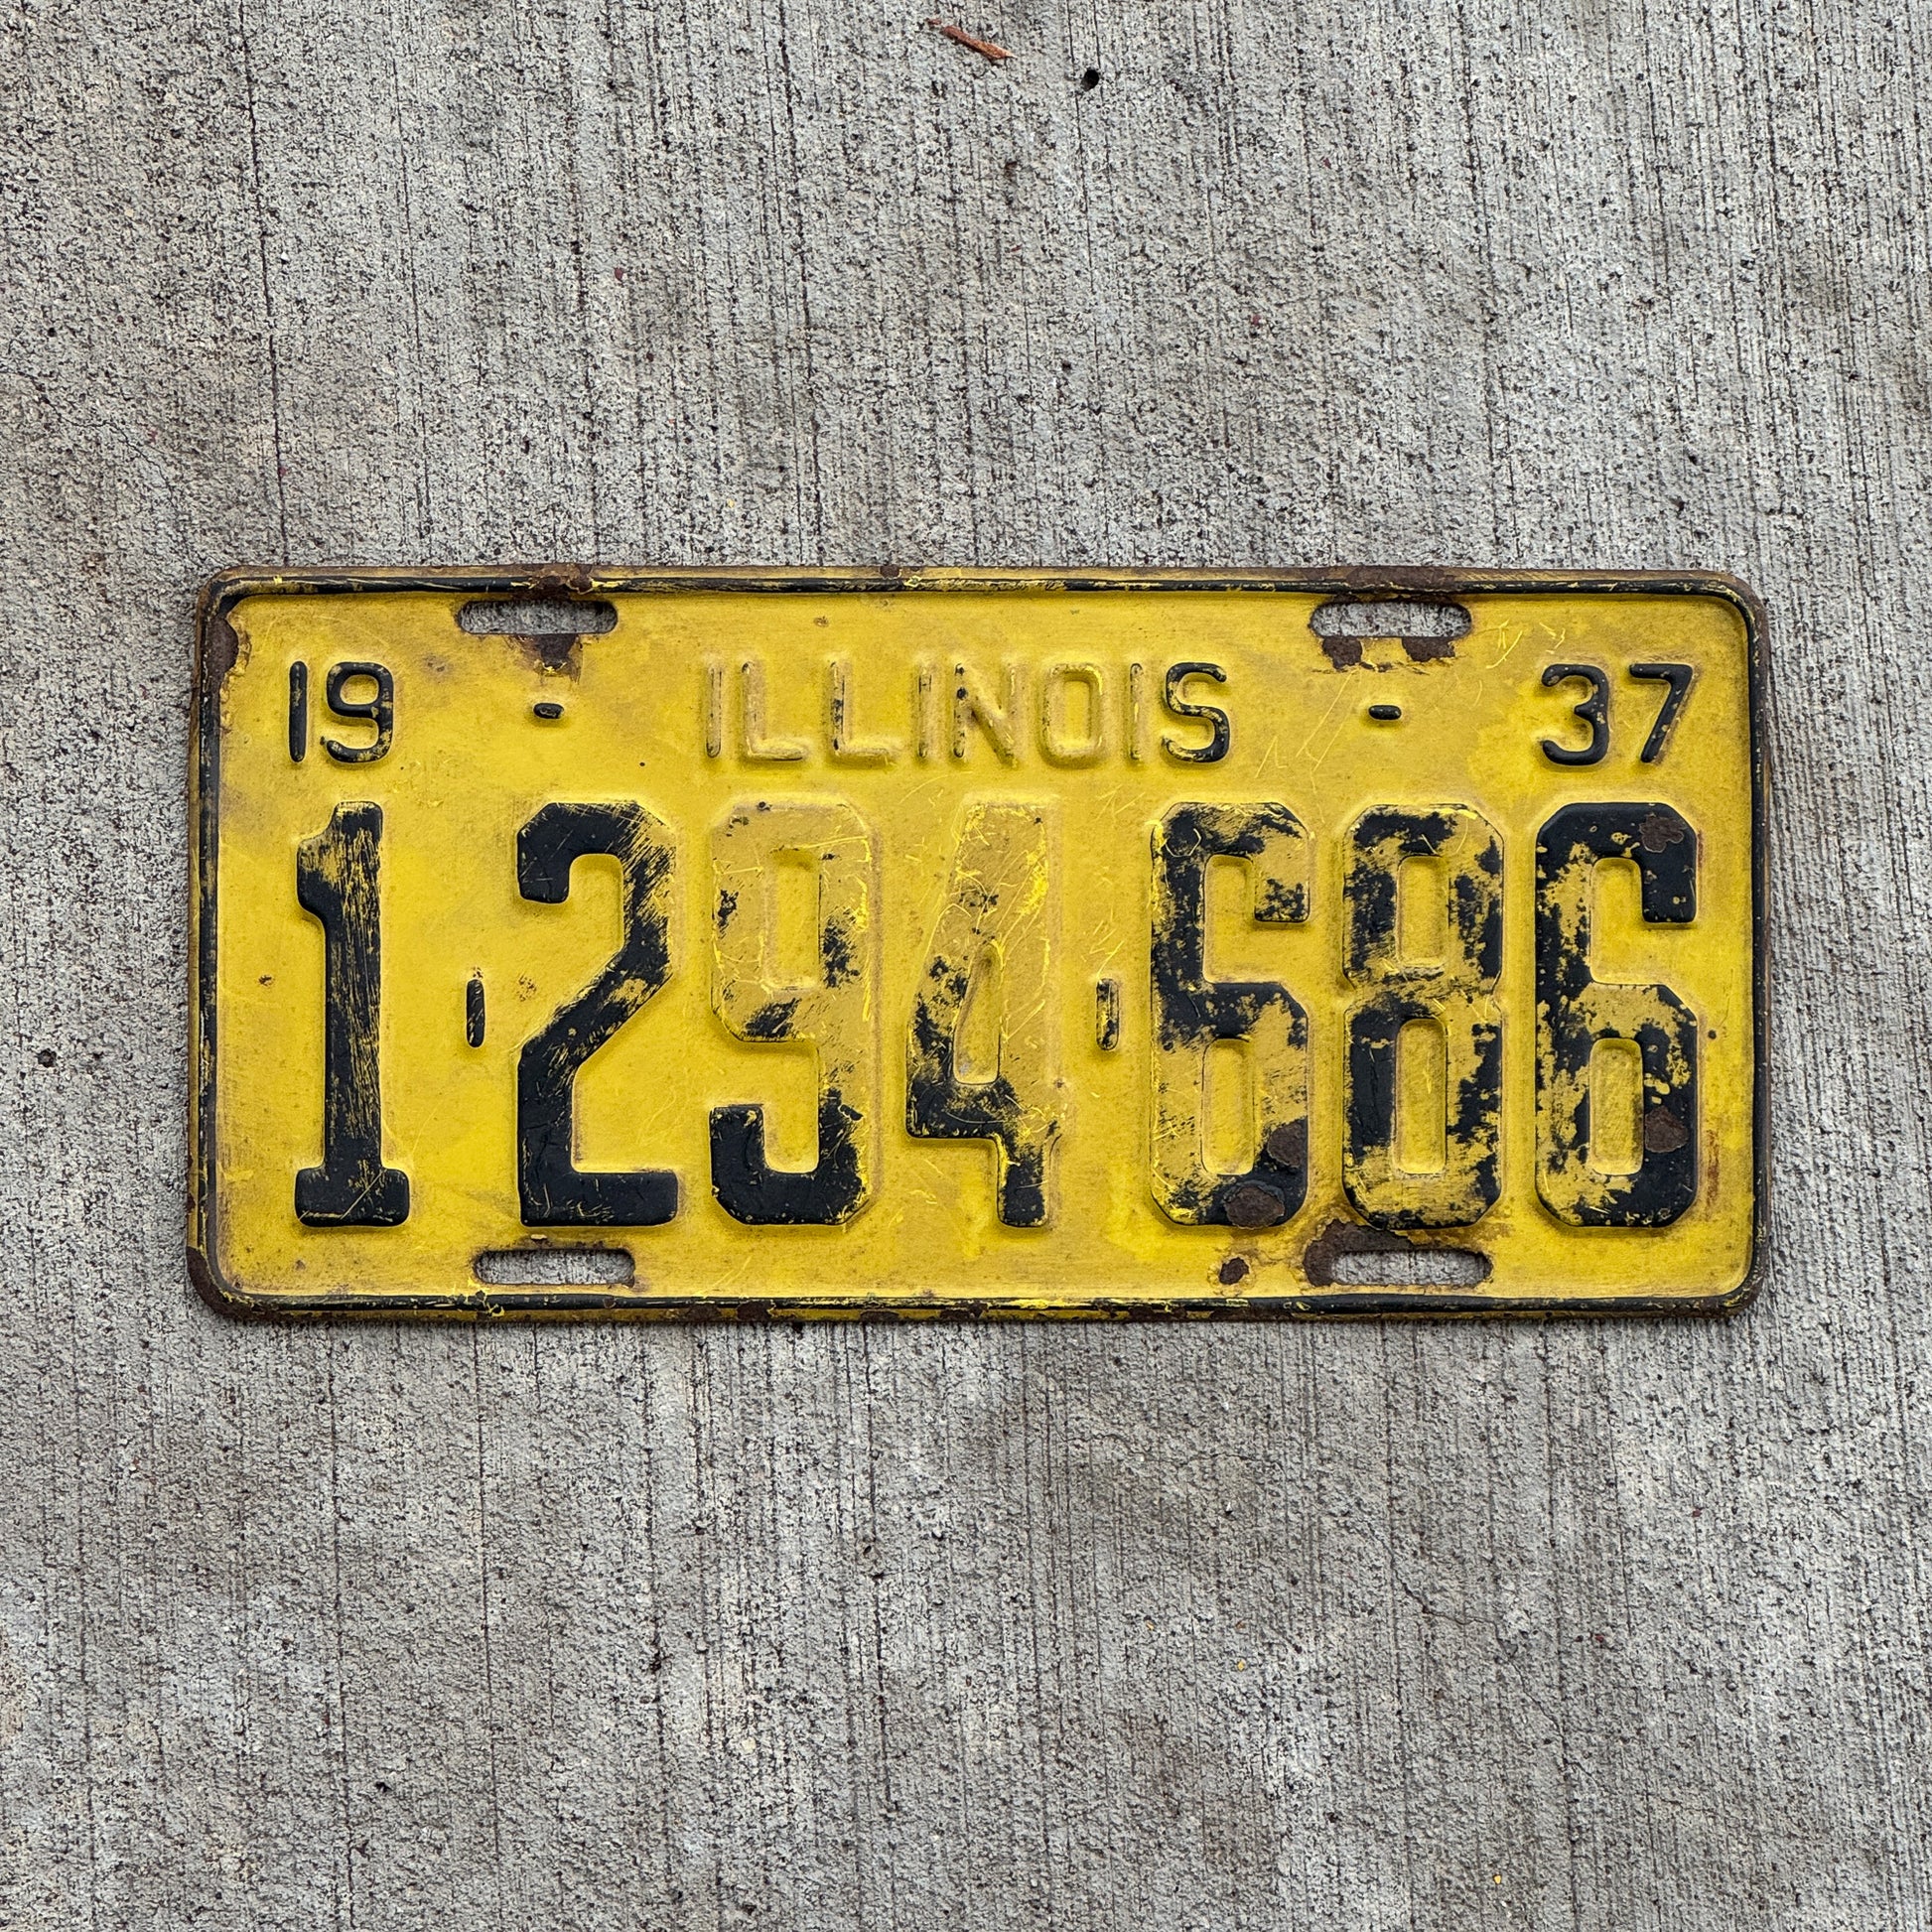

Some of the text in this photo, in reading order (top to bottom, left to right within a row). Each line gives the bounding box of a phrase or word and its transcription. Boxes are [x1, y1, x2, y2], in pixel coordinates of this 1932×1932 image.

[289, 659, 1697, 765] 19 ILLINOIS 37
